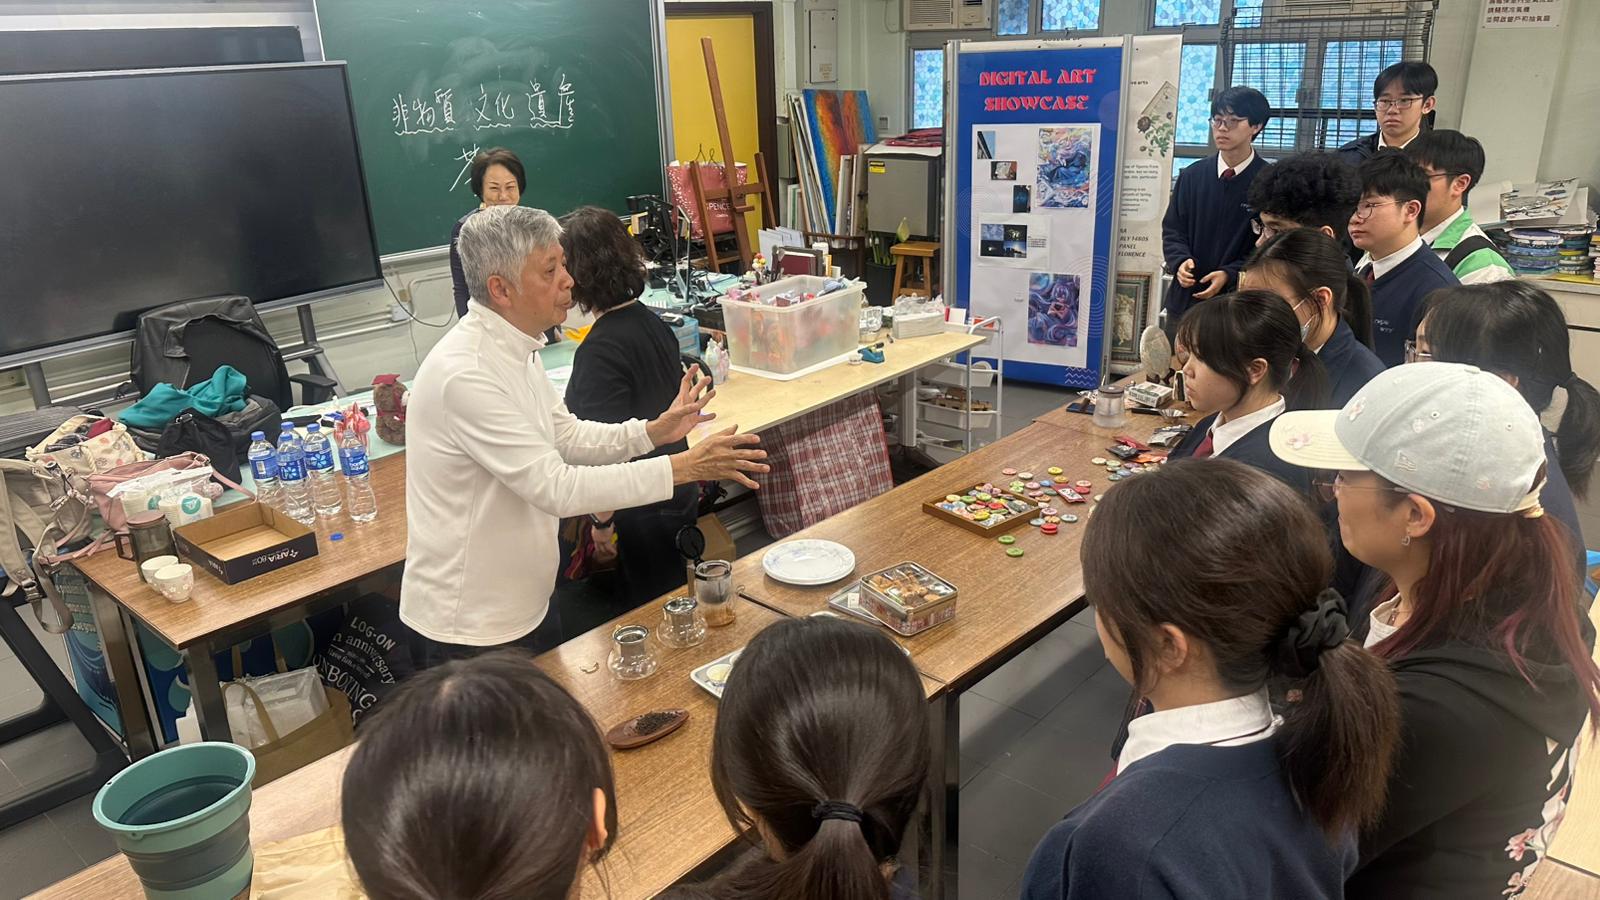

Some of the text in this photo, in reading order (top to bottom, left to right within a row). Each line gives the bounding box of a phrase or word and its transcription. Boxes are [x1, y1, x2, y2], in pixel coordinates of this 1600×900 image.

[979, 68, 1097, 86] DIGITAL ART
[474, 83, 515, 122] 文化
[984, 95, 1089, 111] SHOWCASE
[350, 616, 396, 651] LOG-ON
